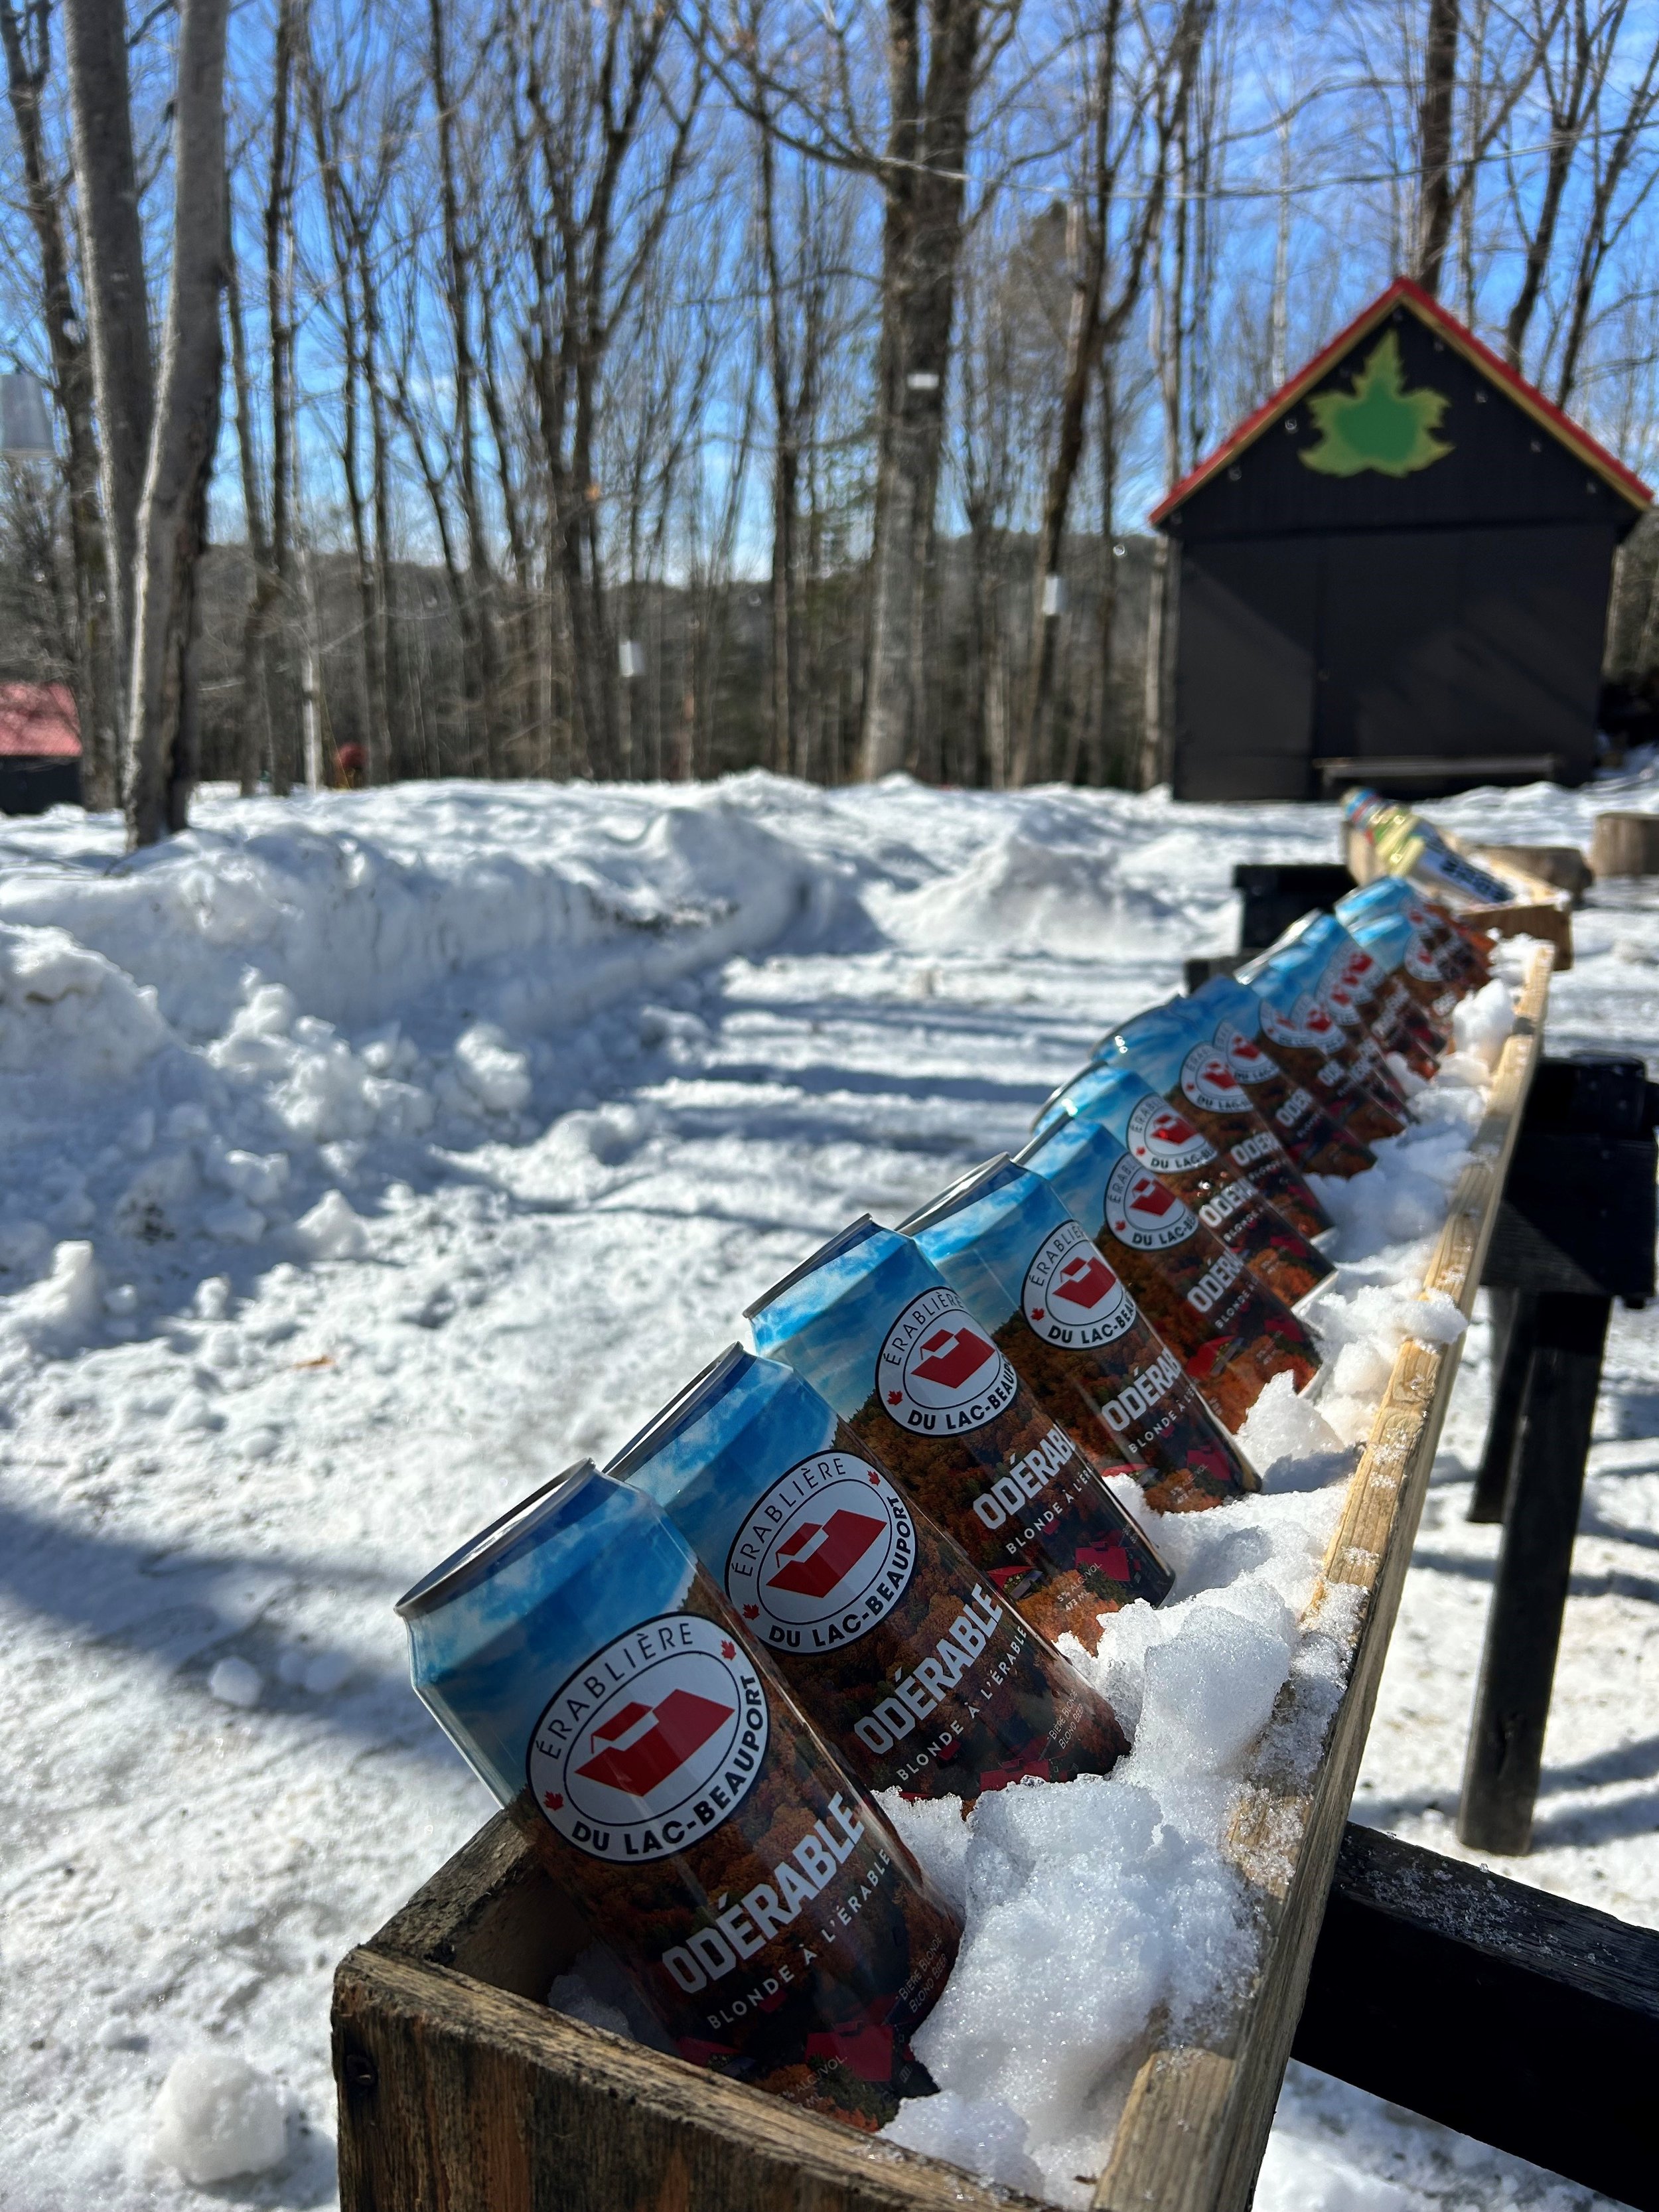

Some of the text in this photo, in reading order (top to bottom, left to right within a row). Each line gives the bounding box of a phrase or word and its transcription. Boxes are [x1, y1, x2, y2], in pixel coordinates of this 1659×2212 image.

[1150, 1157, 1169, 1169] DU
[1131, 1232, 1153, 1246] DU
[1048, 1325, 1073, 1343] DU
[907, 1409, 936, 1430] DU
[1128, 1410, 1177, 1454] BLONDE
[731, 1457, 846, 1578] ÉRABLIÈRE
[1005, 1501, 1062, 1554] BLONDE
[1062, 1489, 1074, 1504] À
[768, 1496, 912, 1647] DU LAC-BEAUPORT
[535, 1622, 693, 1760] ÉRABLIÈRE
[853, 1583, 1003, 1755] ODÉRABLE
[896, 1625, 1028, 1782] BLONDE À L'ÉRABLE
[1048, 1715, 1066, 1740] BIÈRE
[1058, 1703, 1084, 1749] BLOND BEER
[571, 1674, 765, 1855] DU LAC-BEAUPORT
[662, 1791, 866, 1994] ODÉRABLE
[706, 1848, 891, 2030] BLONDE À L'ÉRABLE
[898, 1968, 922, 2002] BIÈRE
[908, 1953, 948, 2014] BLOND BEER
